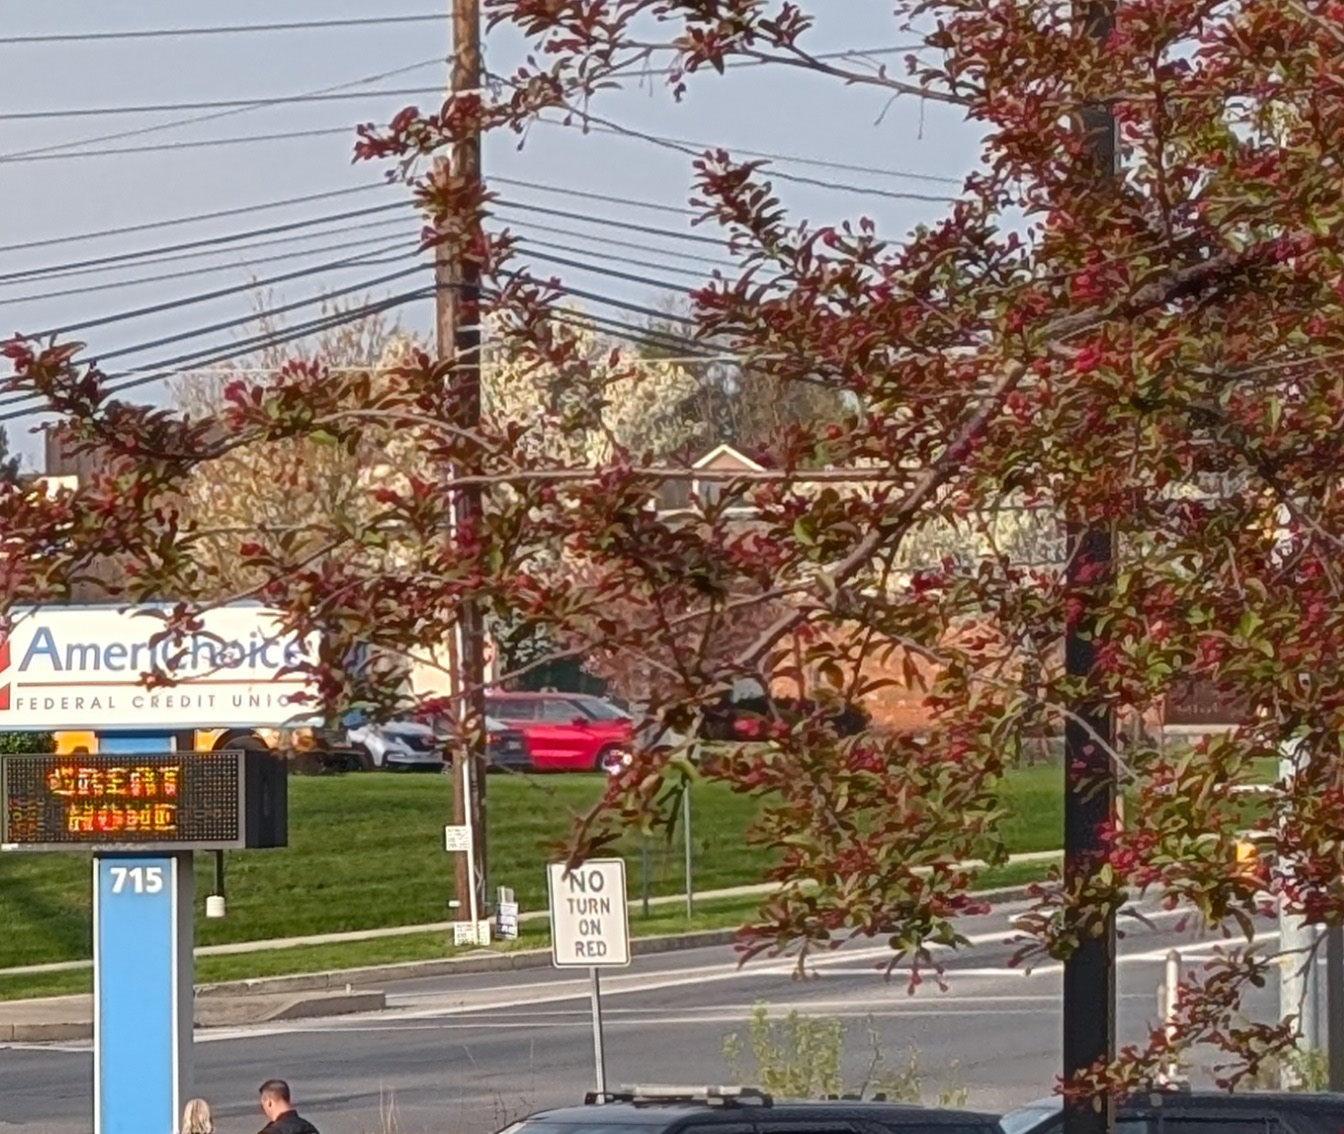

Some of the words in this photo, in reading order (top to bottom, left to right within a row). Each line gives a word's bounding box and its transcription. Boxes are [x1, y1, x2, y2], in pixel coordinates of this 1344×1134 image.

[18, 626, 309, 673] AmeriChoice
[17, 696, 116, 710] FEDERAL
[132, 694, 217, 709] CREDIT
[231, 694, 311, 708] UNIO
[46, 765, 181, 797] GREAT
[110, 867, 163, 893] 715
[569, 870, 605, 893] NO
[566, 897, 611, 915] TURN
[579, 919, 602, 936] ON
[575, 940, 607, 957] RED
